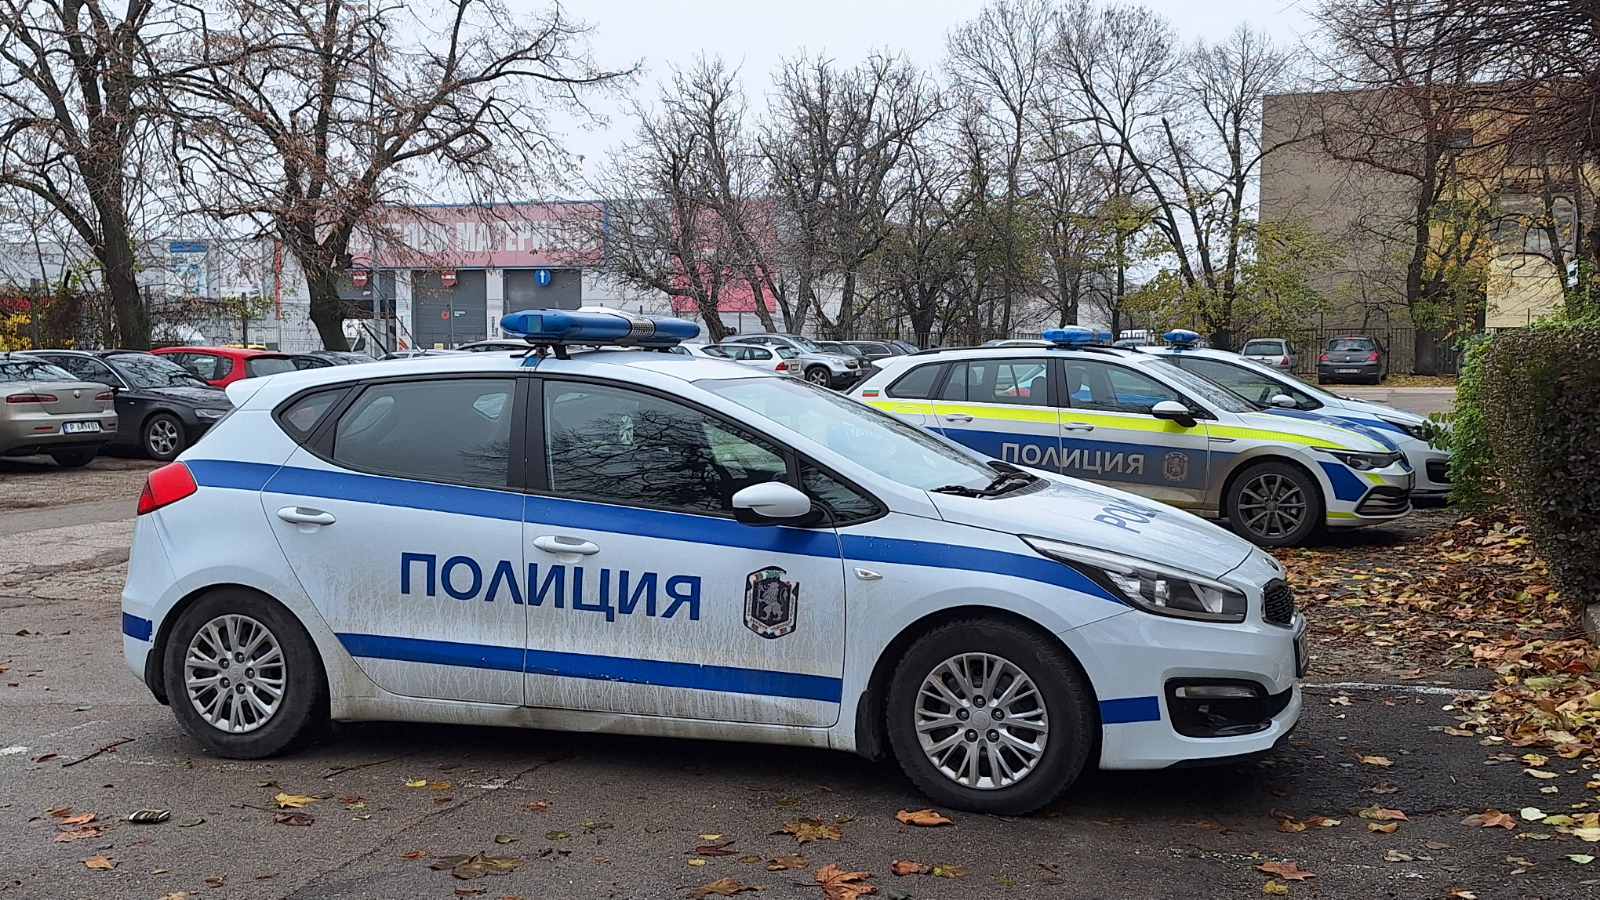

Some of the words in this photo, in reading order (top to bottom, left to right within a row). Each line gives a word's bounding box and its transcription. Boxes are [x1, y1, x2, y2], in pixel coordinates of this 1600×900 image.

[1001, 442, 1145, 474] ПОЛИЦИЯ
[1094, 500, 1157, 534] POL
[400, 552, 701, 622] ПОЛИЦИЯ
